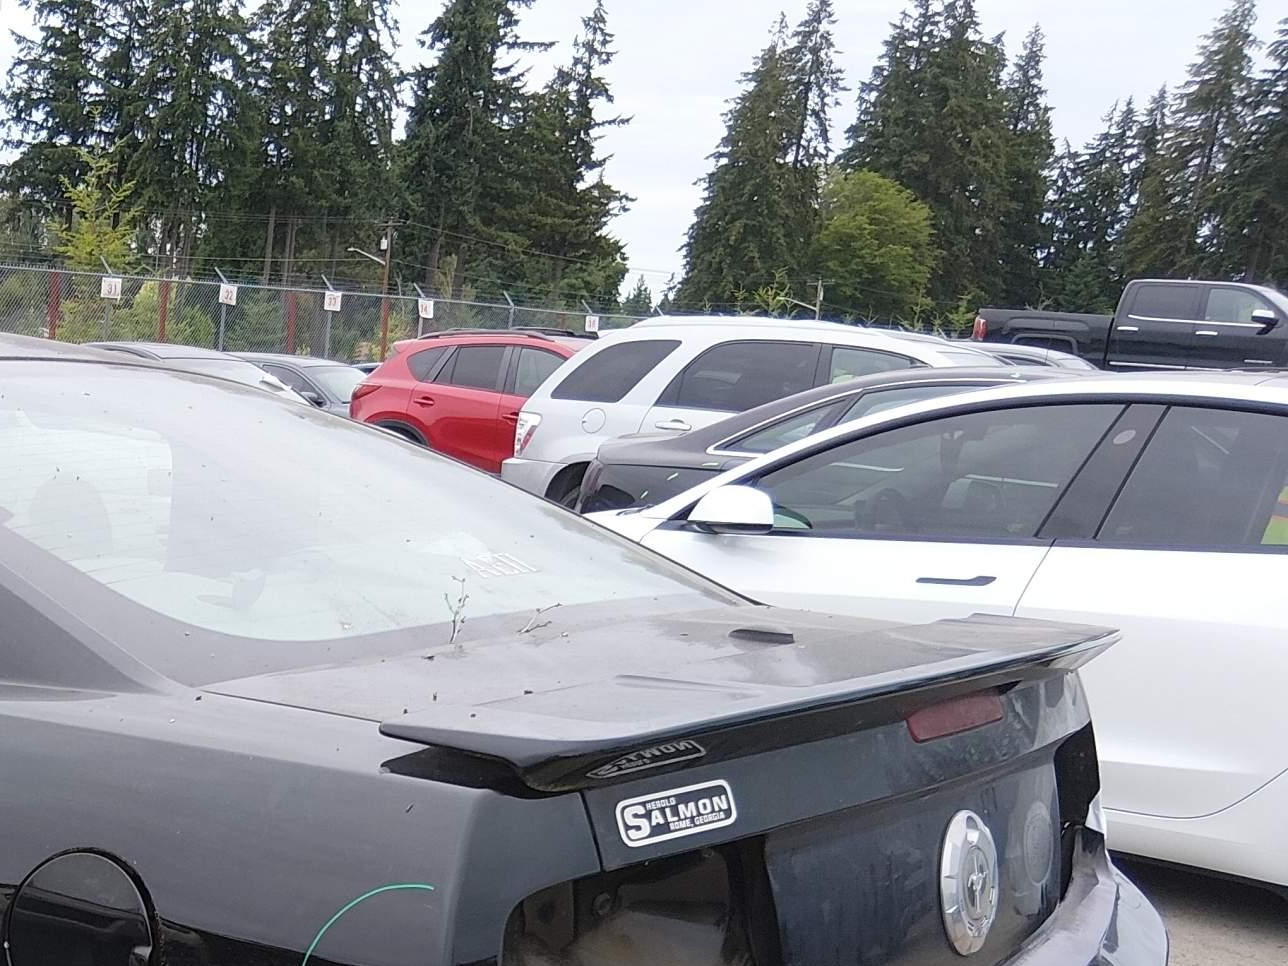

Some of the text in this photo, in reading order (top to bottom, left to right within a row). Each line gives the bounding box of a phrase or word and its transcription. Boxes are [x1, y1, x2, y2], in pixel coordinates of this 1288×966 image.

[646, 797, 677, 811] HEROLD
[623, 794, 729, 840] SALMON
[669, 812, 726, 831] ROME, GEORGIA
